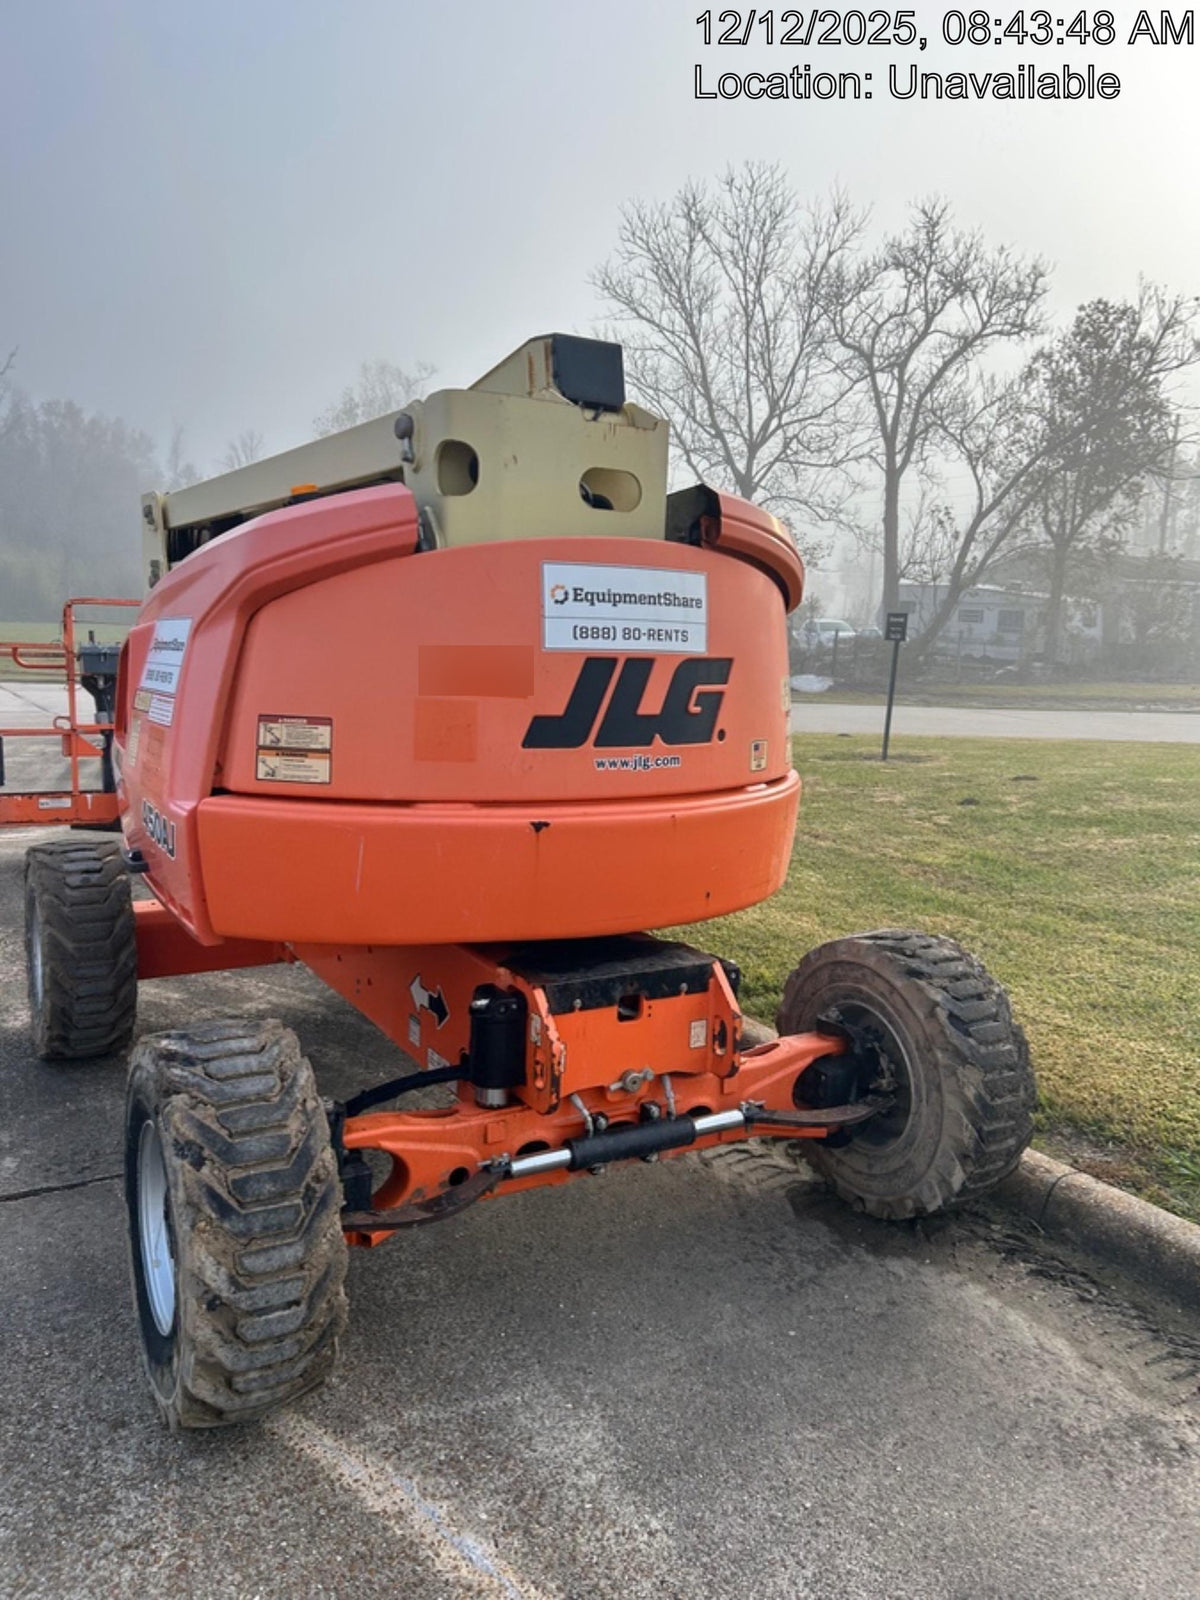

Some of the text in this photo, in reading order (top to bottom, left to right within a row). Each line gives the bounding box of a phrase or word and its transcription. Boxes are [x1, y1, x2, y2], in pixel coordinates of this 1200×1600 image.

[572, 587, 703, 609] EquipmentShare
[572, 625, 689, 643] (888) 80-RENTS
[594, 755, 681, 770] www.jlg.com
